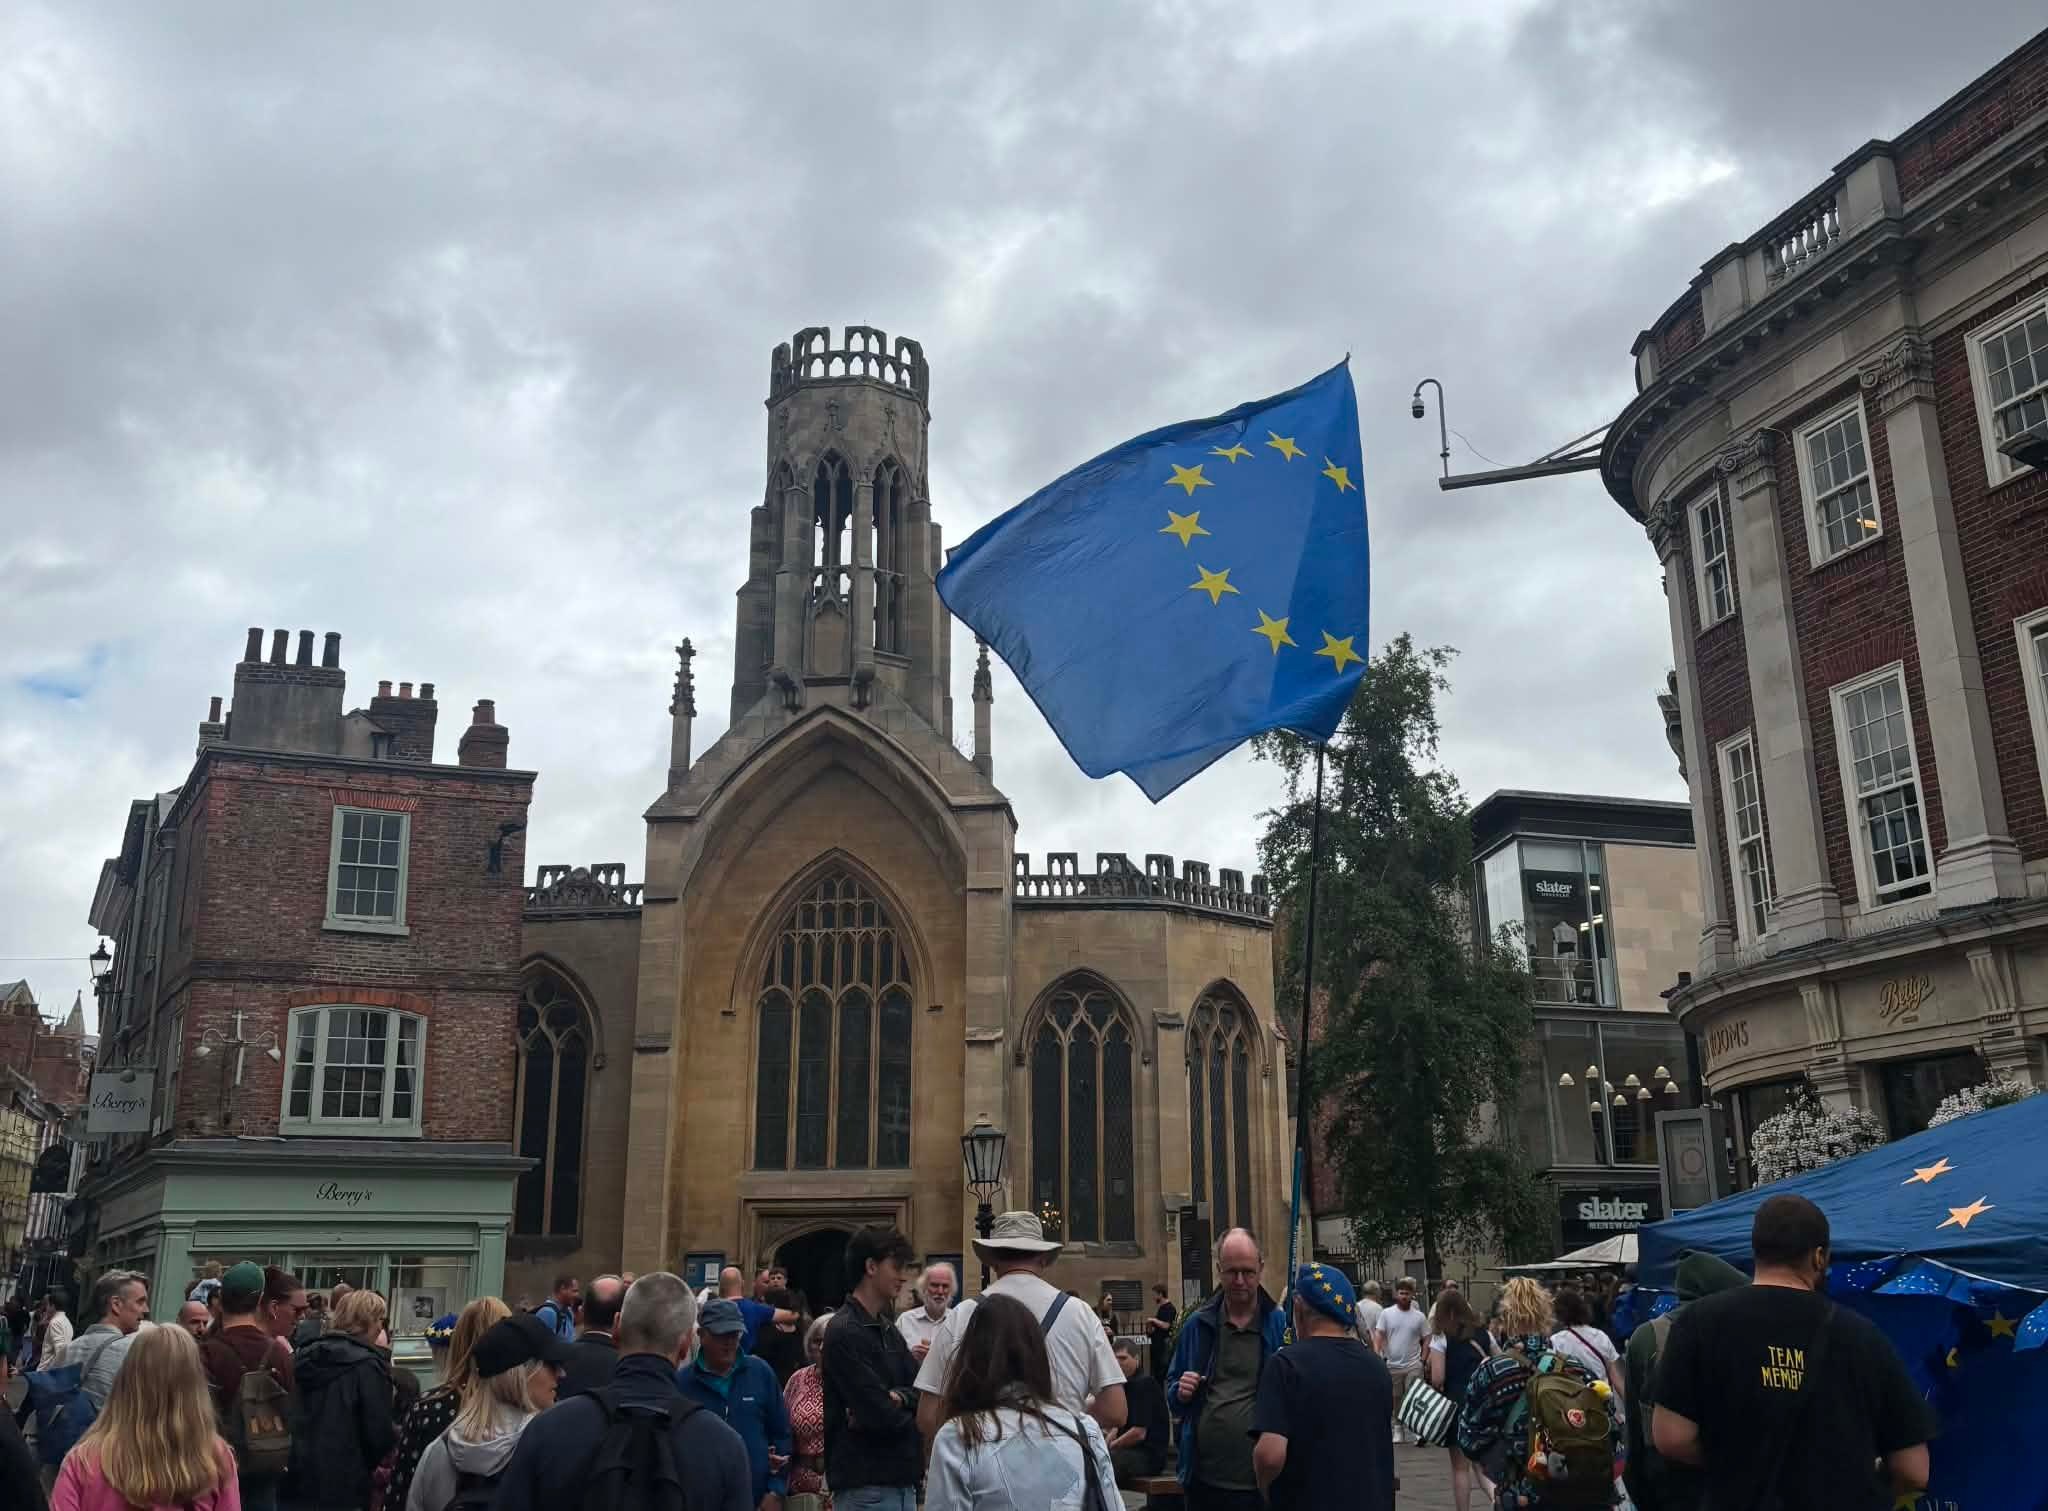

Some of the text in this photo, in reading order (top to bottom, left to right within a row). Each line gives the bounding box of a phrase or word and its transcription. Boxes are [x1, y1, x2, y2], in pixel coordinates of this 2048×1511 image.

[1535, 880, 1573, 894] slater
[92, 1091, 145, 1113] Berry's
[316, 1182, 374, 1208] Berry's
[1578, 1196, 1649, 1221] slater
[1767, 1345, 1804, 1370] TEAM
